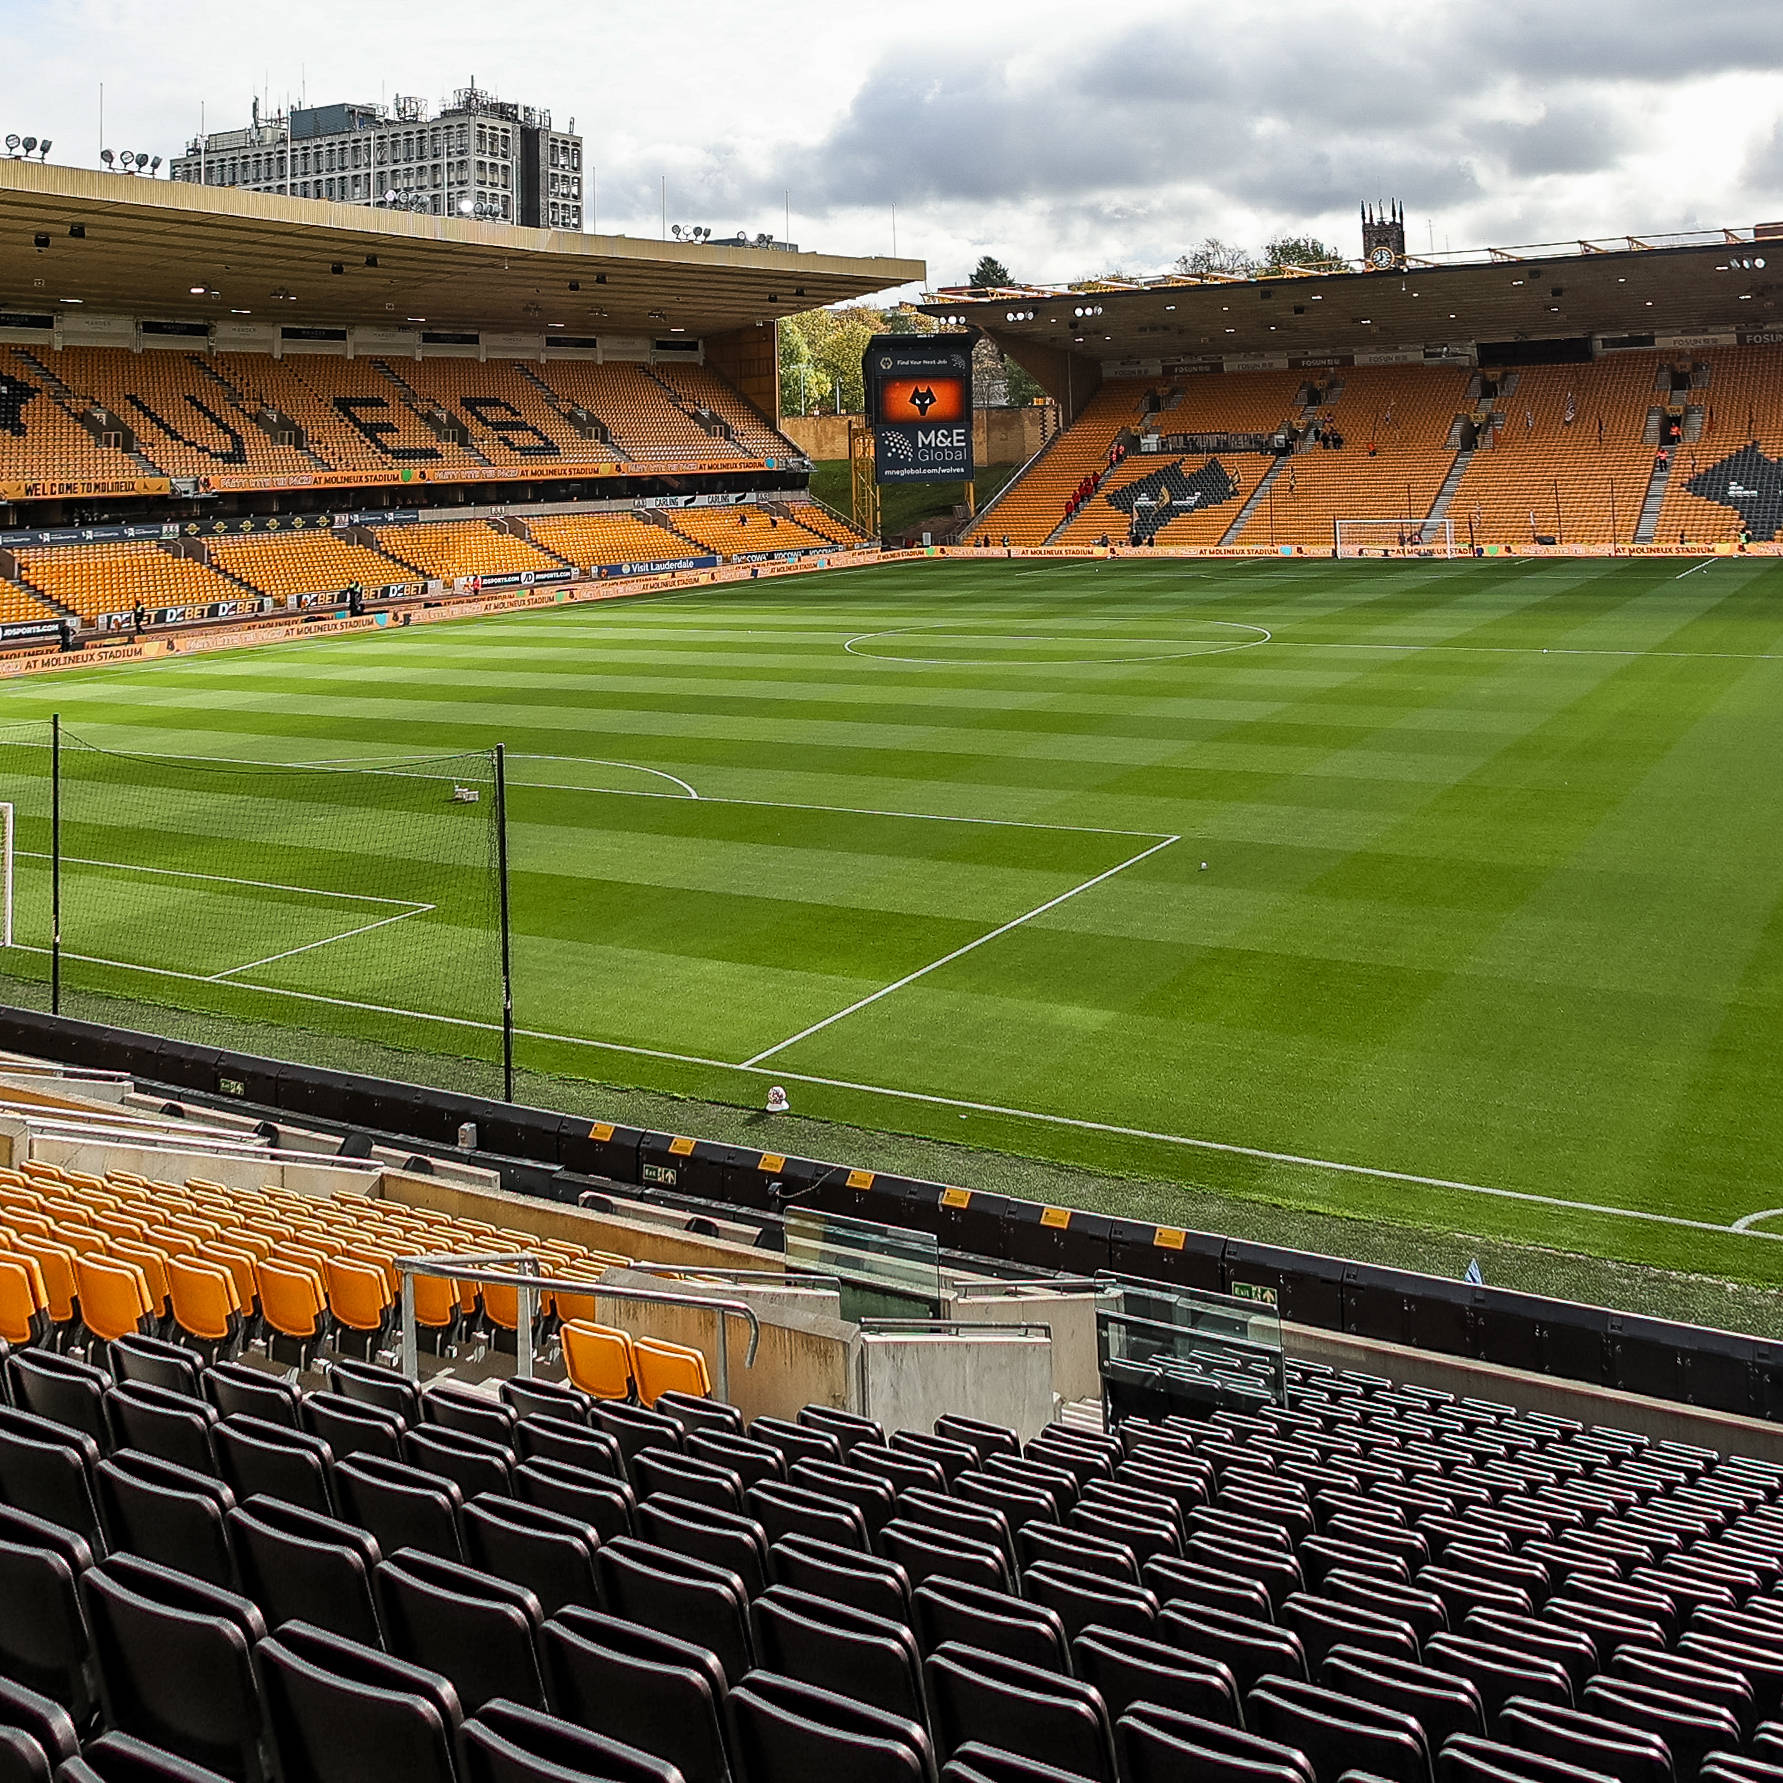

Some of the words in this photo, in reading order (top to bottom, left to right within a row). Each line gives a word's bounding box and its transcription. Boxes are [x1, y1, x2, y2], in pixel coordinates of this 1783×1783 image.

[1673, 337, 1702, 347] FOSUN
[1175, 365, 1198, 373] FOSUN
[1238, 362, 1260, 370] FOSUN
[1302, 359, 1326, 367] FOSUN
[918, 429, 966, 448] M&E
[918, 448, 967, 462] Global
[520, 469, 529, 477] AT
[531, 468, 567, 476] MOLINEUX
[568, 467, 598, 476] STADIUM
[884, 466, 965, 477] mneglobal.com/wolves
[313, 475, 323, 484] AT
[324, 474, 364, 484] MOLINEUX
[364, 473, 399, 483] STADIUM
[80, 481, 94, 494] TO
[654, 497, 679, 507] CARLING
[707, 495, 730, 504] CARLING
[902, 549, 924, 557] STADIUM
[632, 562, 648, 572] Visit
[650, 560, 694, 571] Lauderdale
[482, 576, 520, 585] JDSPORTS.COM
[523, 573, 534, 583] JD
[649, 581, 676, 590] MOLINEUX
[677, 578, 699, 587] STADIUM
[389, 582, 424, 598] DEBET
[484, 602, 496, 611] AT
[497, 599, 526, 610] MOLINEUX
[527, 596, 554, 607] STADIUM
[165, 604, 211, 624] DEBET
[218, 599, 260, 618] DEBET
[3, 624, 59, 638] JDSPORTS.COM
[284, 628, 294, 637] AT
[297, 622, 338, 635] MOLINEUX
[339, 617, 374, 630] STADIUM
[24, 659, 38, 670] AT
[41, 654, 96, 667] MOLINEUX
[97, 647, 143, 661] STADIUM
[1234, 1287, 1250, 1297] Exit
